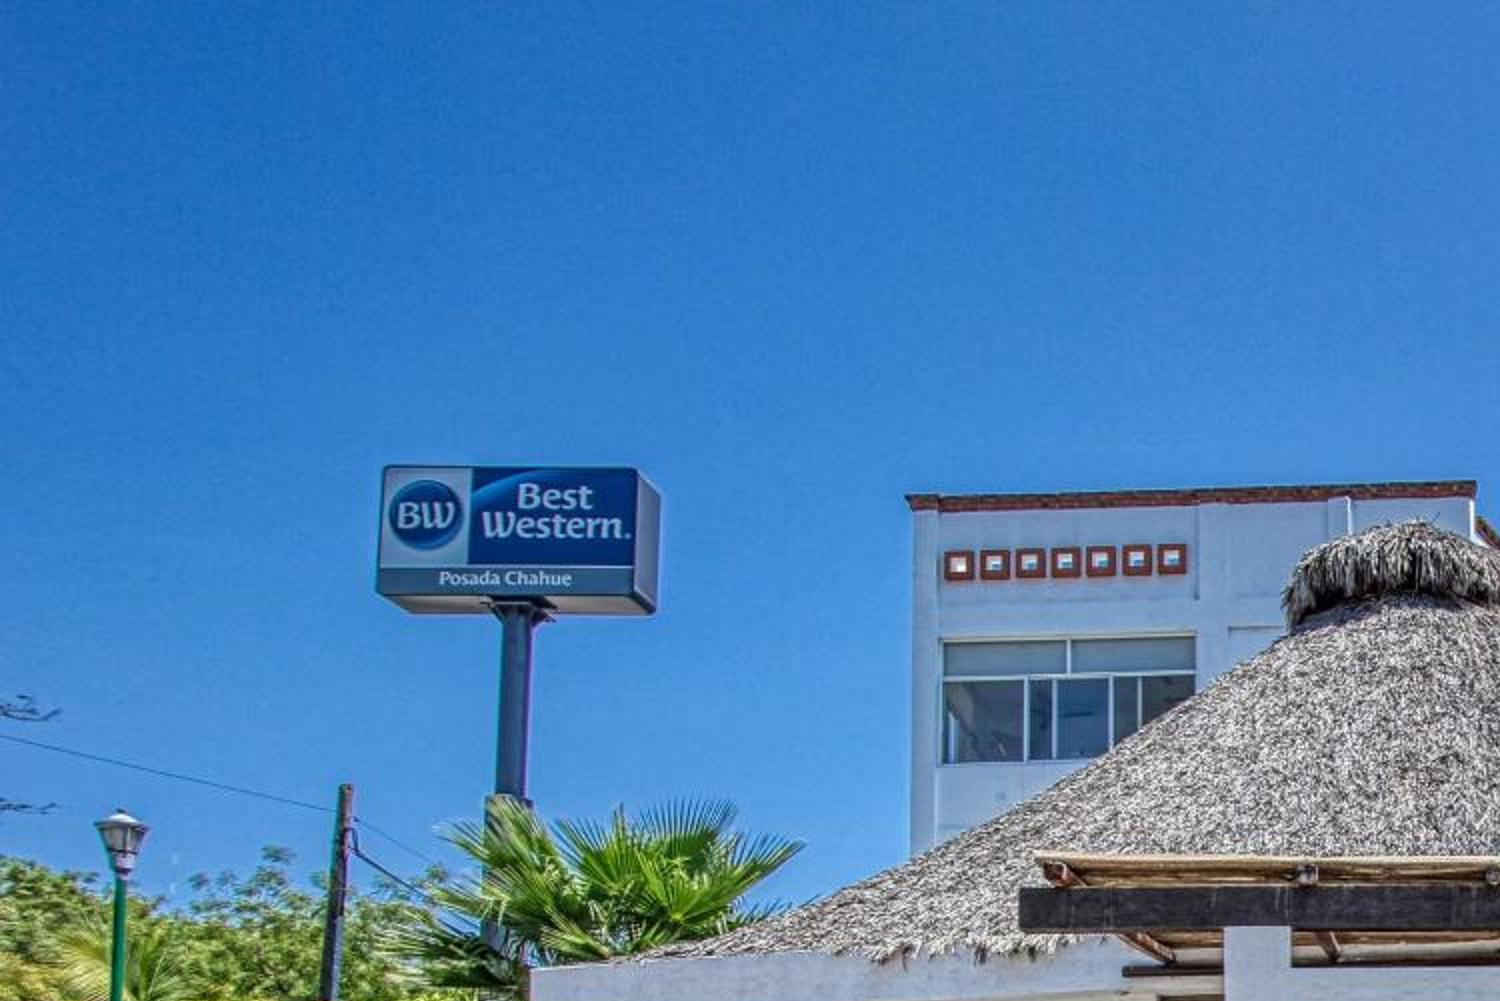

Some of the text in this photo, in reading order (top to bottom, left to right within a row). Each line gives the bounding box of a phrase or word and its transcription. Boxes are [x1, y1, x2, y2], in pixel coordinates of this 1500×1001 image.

[518, 482, 593, 510] Best
[397, 501, 455, 529] BW
[438, 571, 573, 586] Posada Chahue
